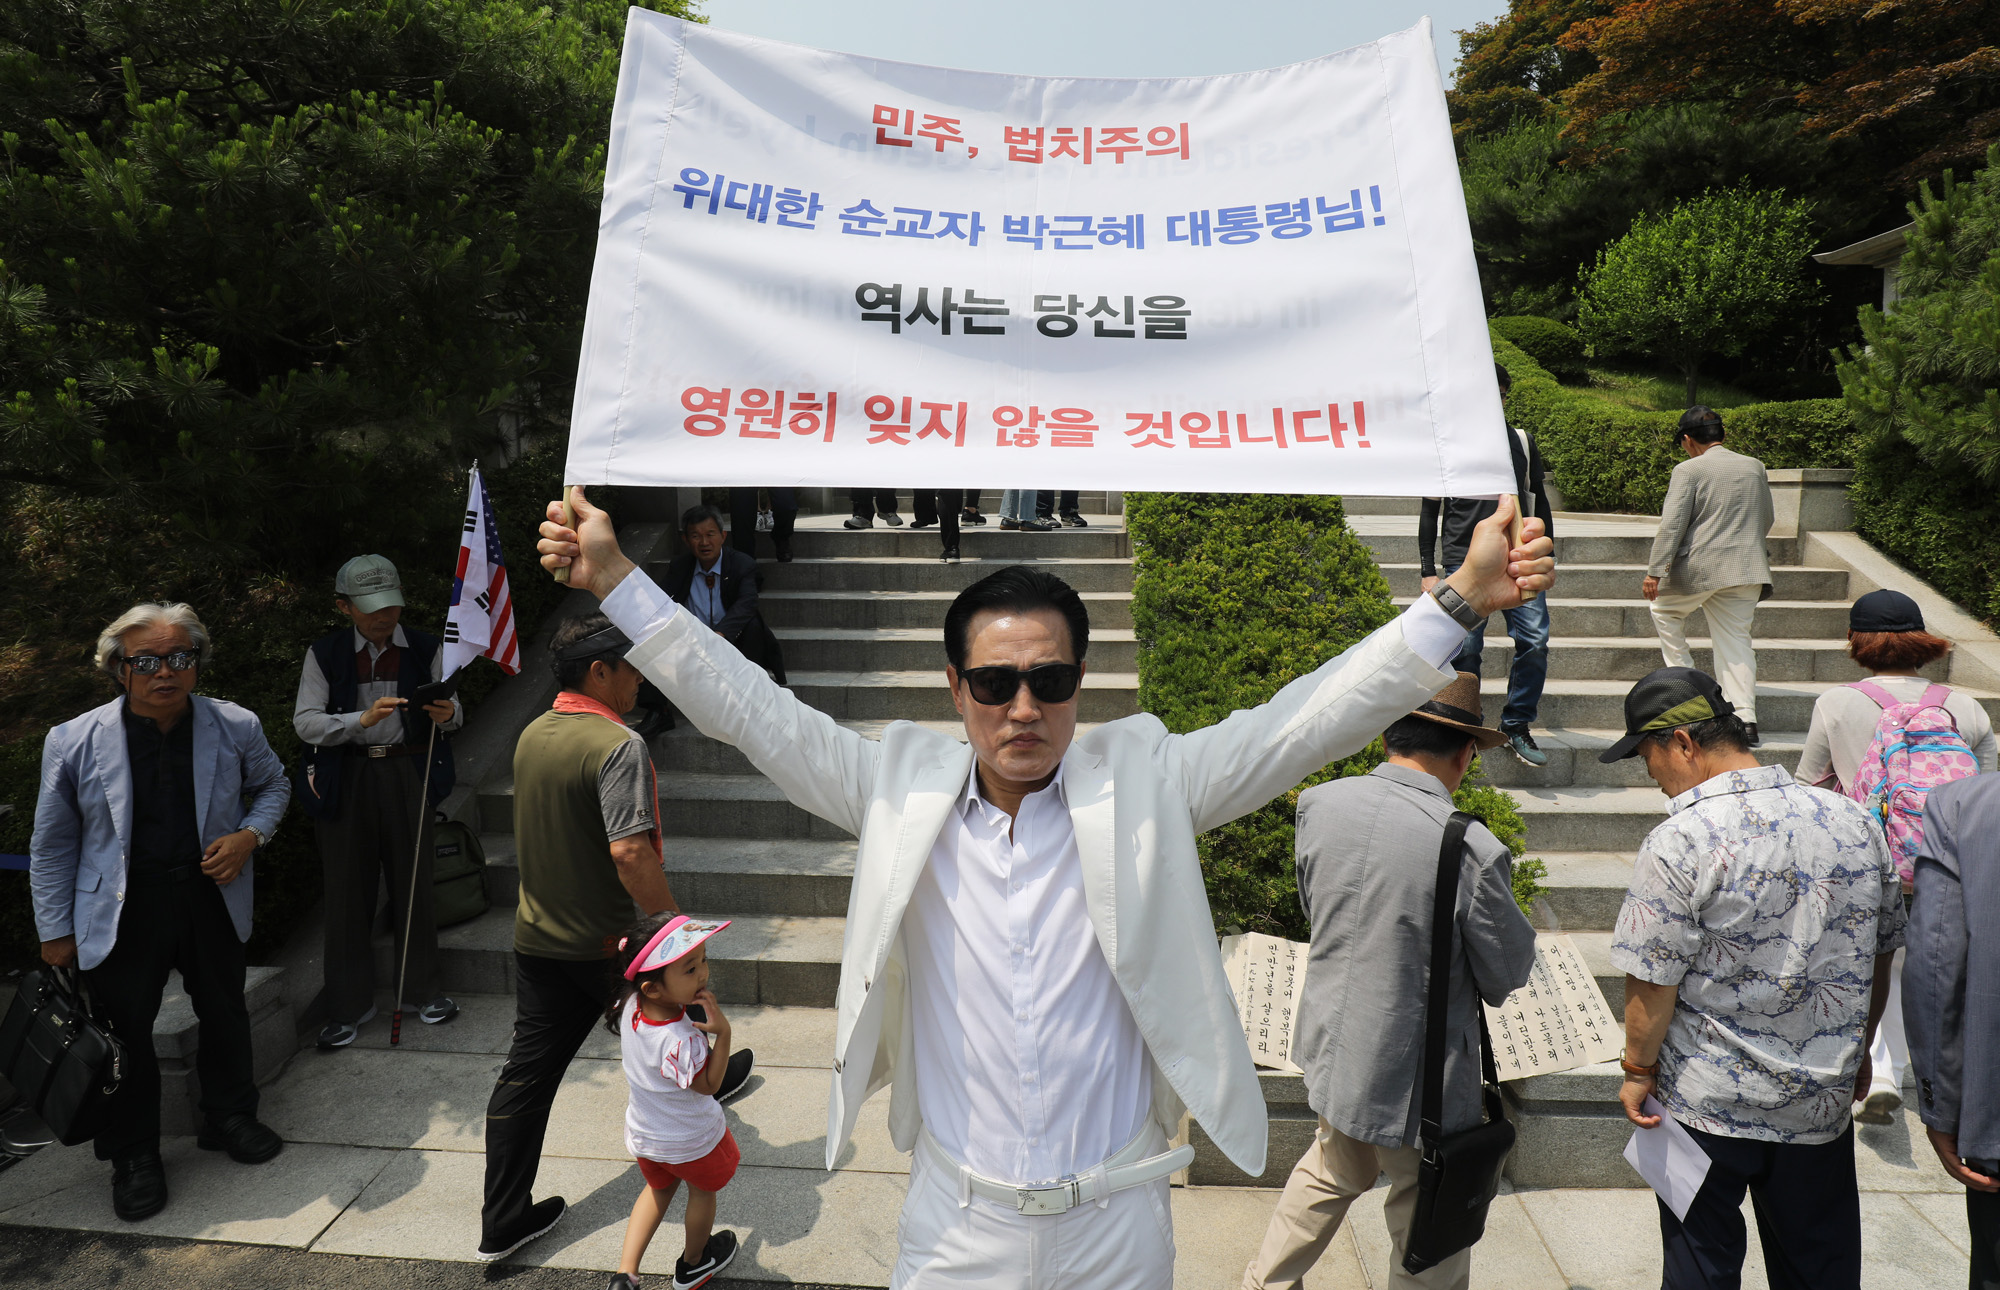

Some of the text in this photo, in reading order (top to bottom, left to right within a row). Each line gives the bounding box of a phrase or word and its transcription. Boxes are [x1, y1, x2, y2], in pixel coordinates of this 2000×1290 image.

[873, 105, 1189, 164] 민주, 법치주의
[674, 168, 1385, 250] 위대한 순교자 박근혜 대통령님!
[855, 283, 1009, 335] 역사는
[1034, 295, 1191, 339] 당신을
[681, 387, 836, 442] 영원히
[864, 395, 967, 447] 잊지
[993, 406, 1099, 447] 않을
[1124, 401, 1370, 448] 것입니다!
